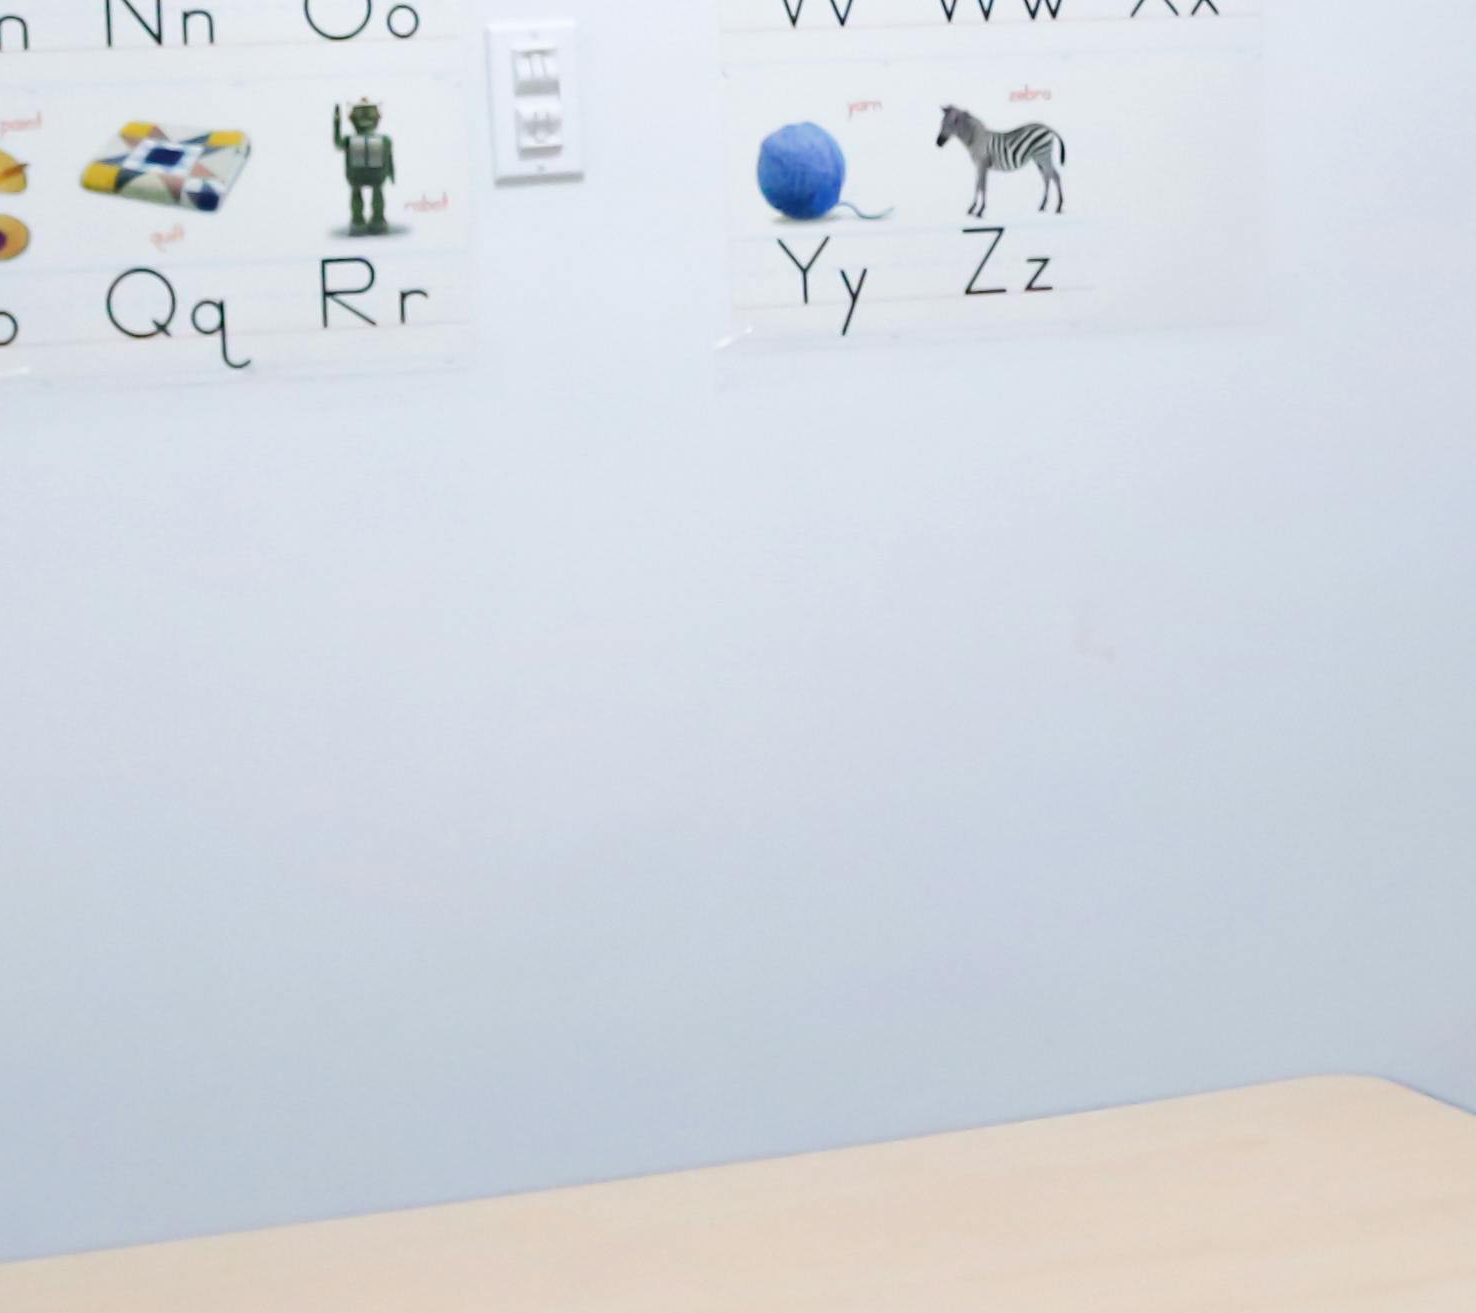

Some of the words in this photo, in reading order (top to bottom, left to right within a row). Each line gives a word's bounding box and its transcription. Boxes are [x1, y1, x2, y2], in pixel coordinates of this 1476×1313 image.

[1008, 83, 1053, 103] zebra
[847, 99, 883, 120] yarn
[403, 191, 450, 213] robot
